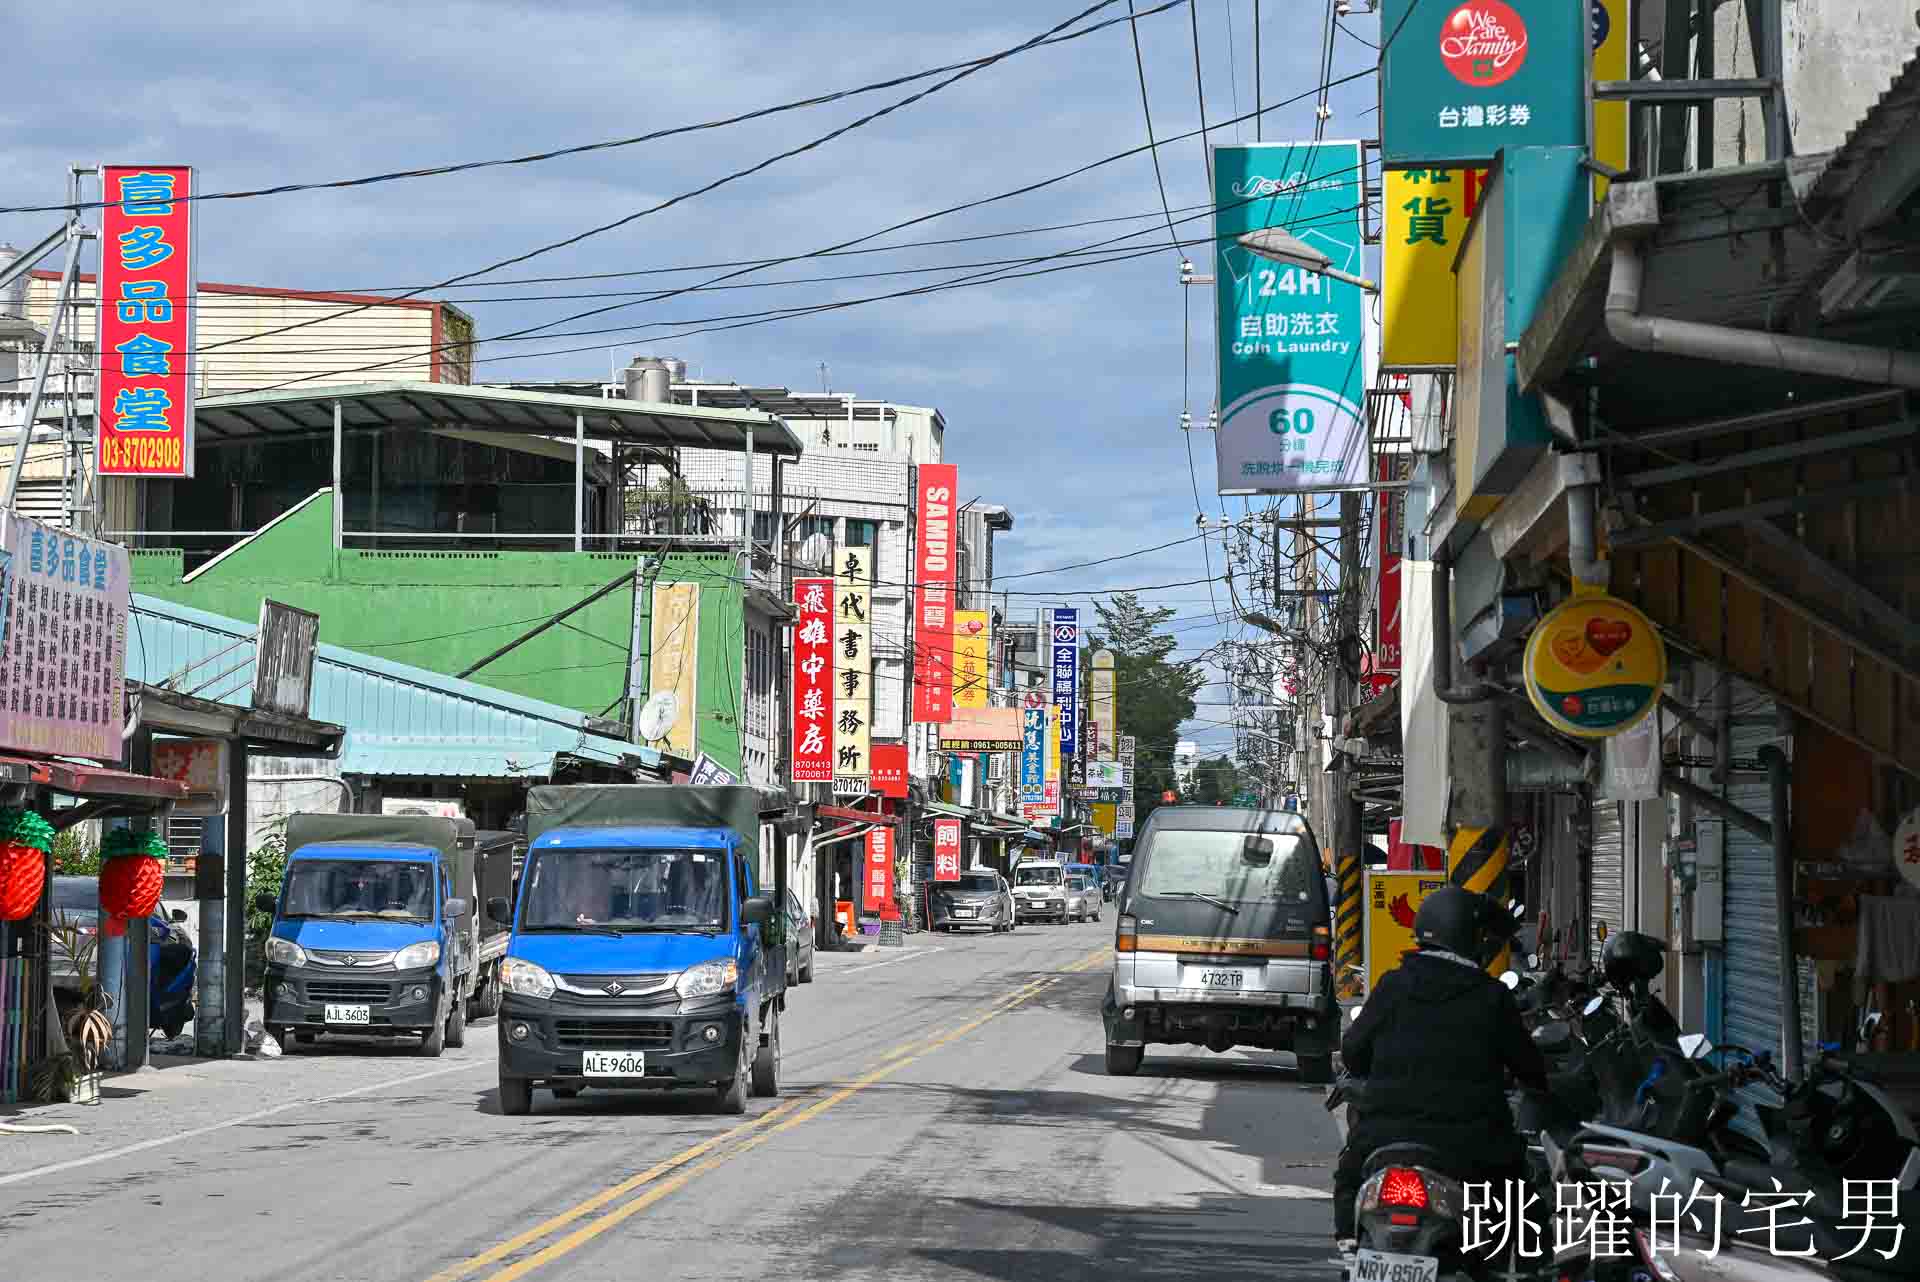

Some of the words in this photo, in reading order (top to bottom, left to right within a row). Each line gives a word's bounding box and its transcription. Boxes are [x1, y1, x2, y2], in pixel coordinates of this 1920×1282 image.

[1467, 8, 1496, 28] We
[1440, 30, 1528, 67] Family
[1439, 104, 1532, 127] 台灣彩券
[1258, 268, 1321, 296] 24H
[114, 172, 176, 432] 喜多品食堂
[1240, 312, 1340, 337] 自助洗衣
[1232, 341, 1271, 355] Coin
[1277, 339, 1351, 354] Laundry
[1269, 408, 1314, 434] 60
[102, 437, 181, 469] 03-8702908
[925, 487, 949, 572] SAMPO
[799, 585, 828, 754] 飛雄中藥房
[838, 552, 865, 773] 卓代書事務所
[1055, 648, 1073, 744] 全聯福利中心
[795, 760, 831, 769] 8701413
[833, 779, 866, 793] 8701271
[936, 825, 959, 876] 飼料
[324, 1006, 369, 1022] AJL-3603
[584, 1057, 643, 1074] ALE-9606
